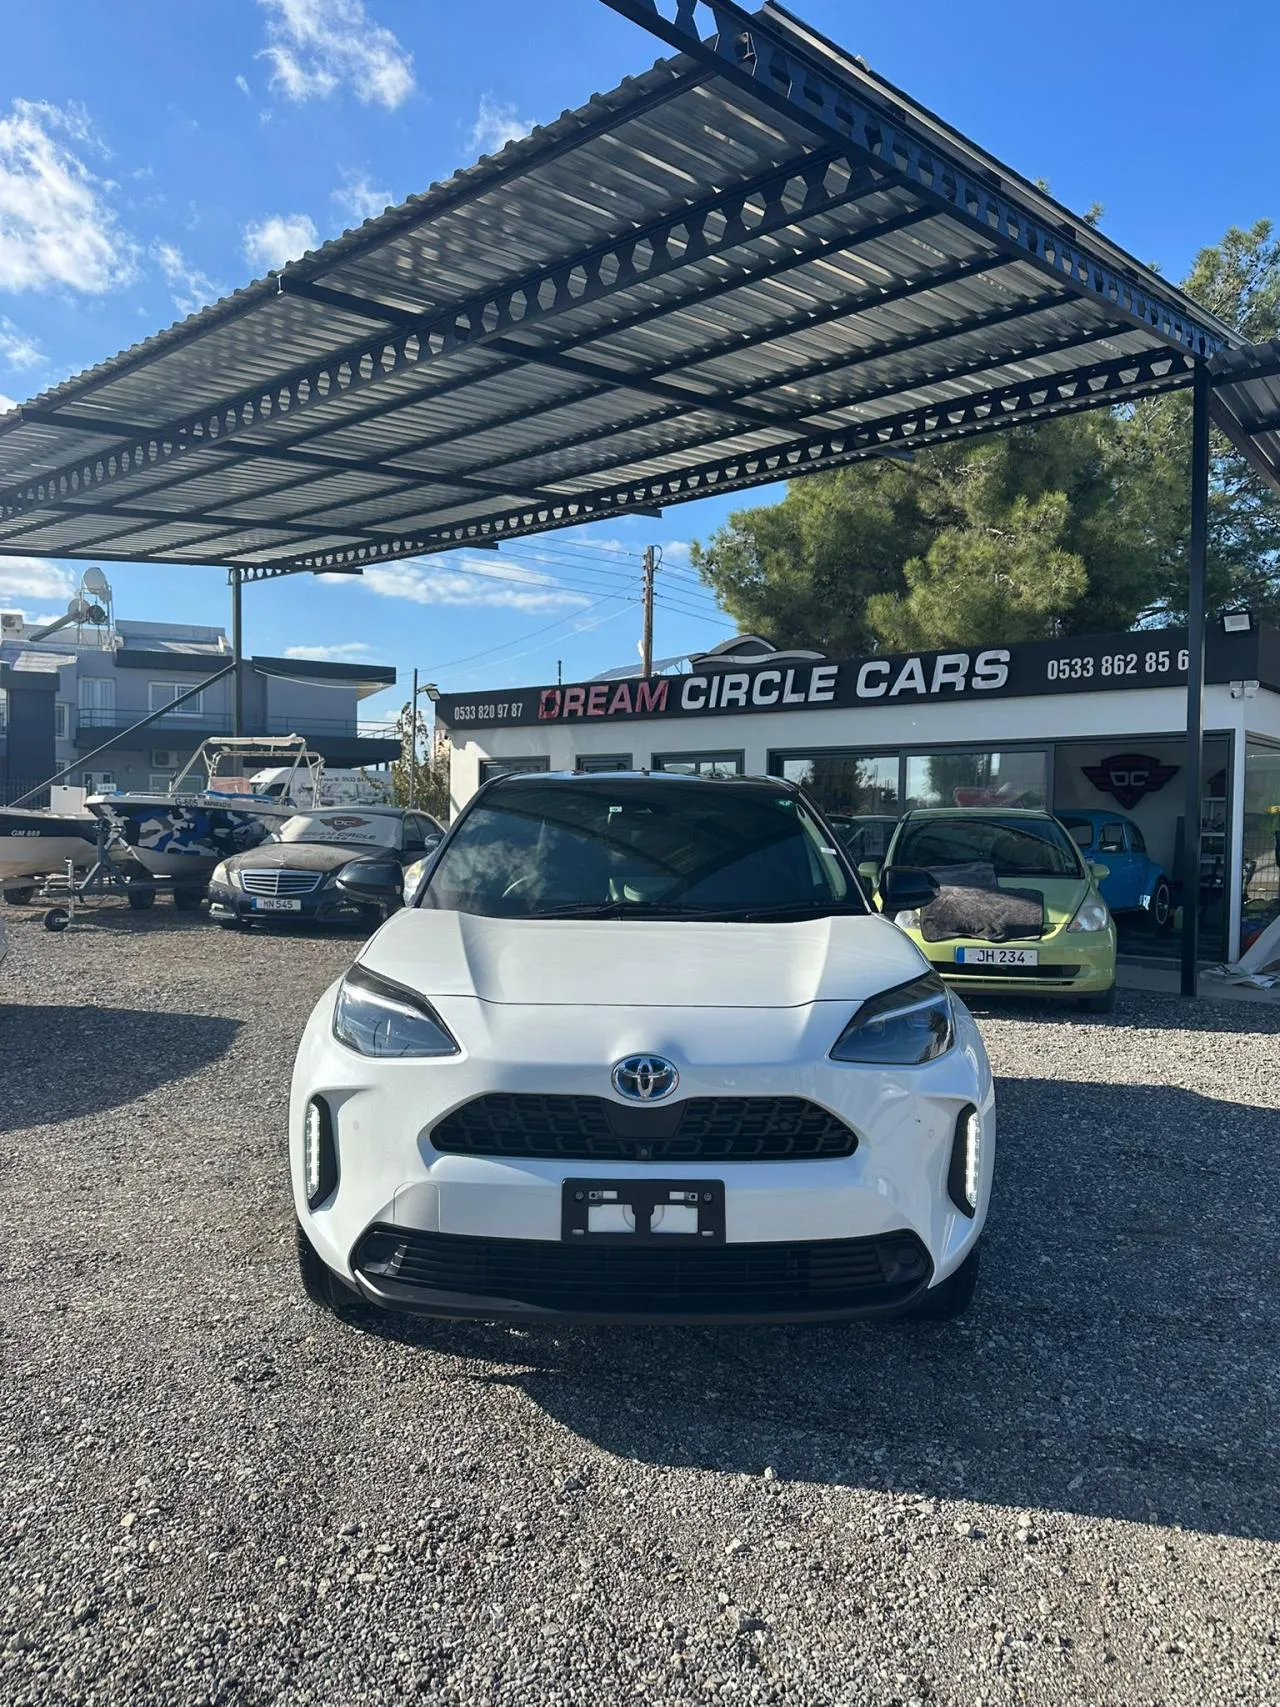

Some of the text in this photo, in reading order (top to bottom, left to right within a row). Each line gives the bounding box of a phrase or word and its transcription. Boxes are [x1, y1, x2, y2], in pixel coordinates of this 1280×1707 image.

[1047, 649, 1190, 680] 0533 862 85 6
[538, 649, 1011, 719] DREAM CIRCLE CARS
[454, 702, 523, 720] 0533 820 97 87
[976, 950, 1025, 964] JH 234
